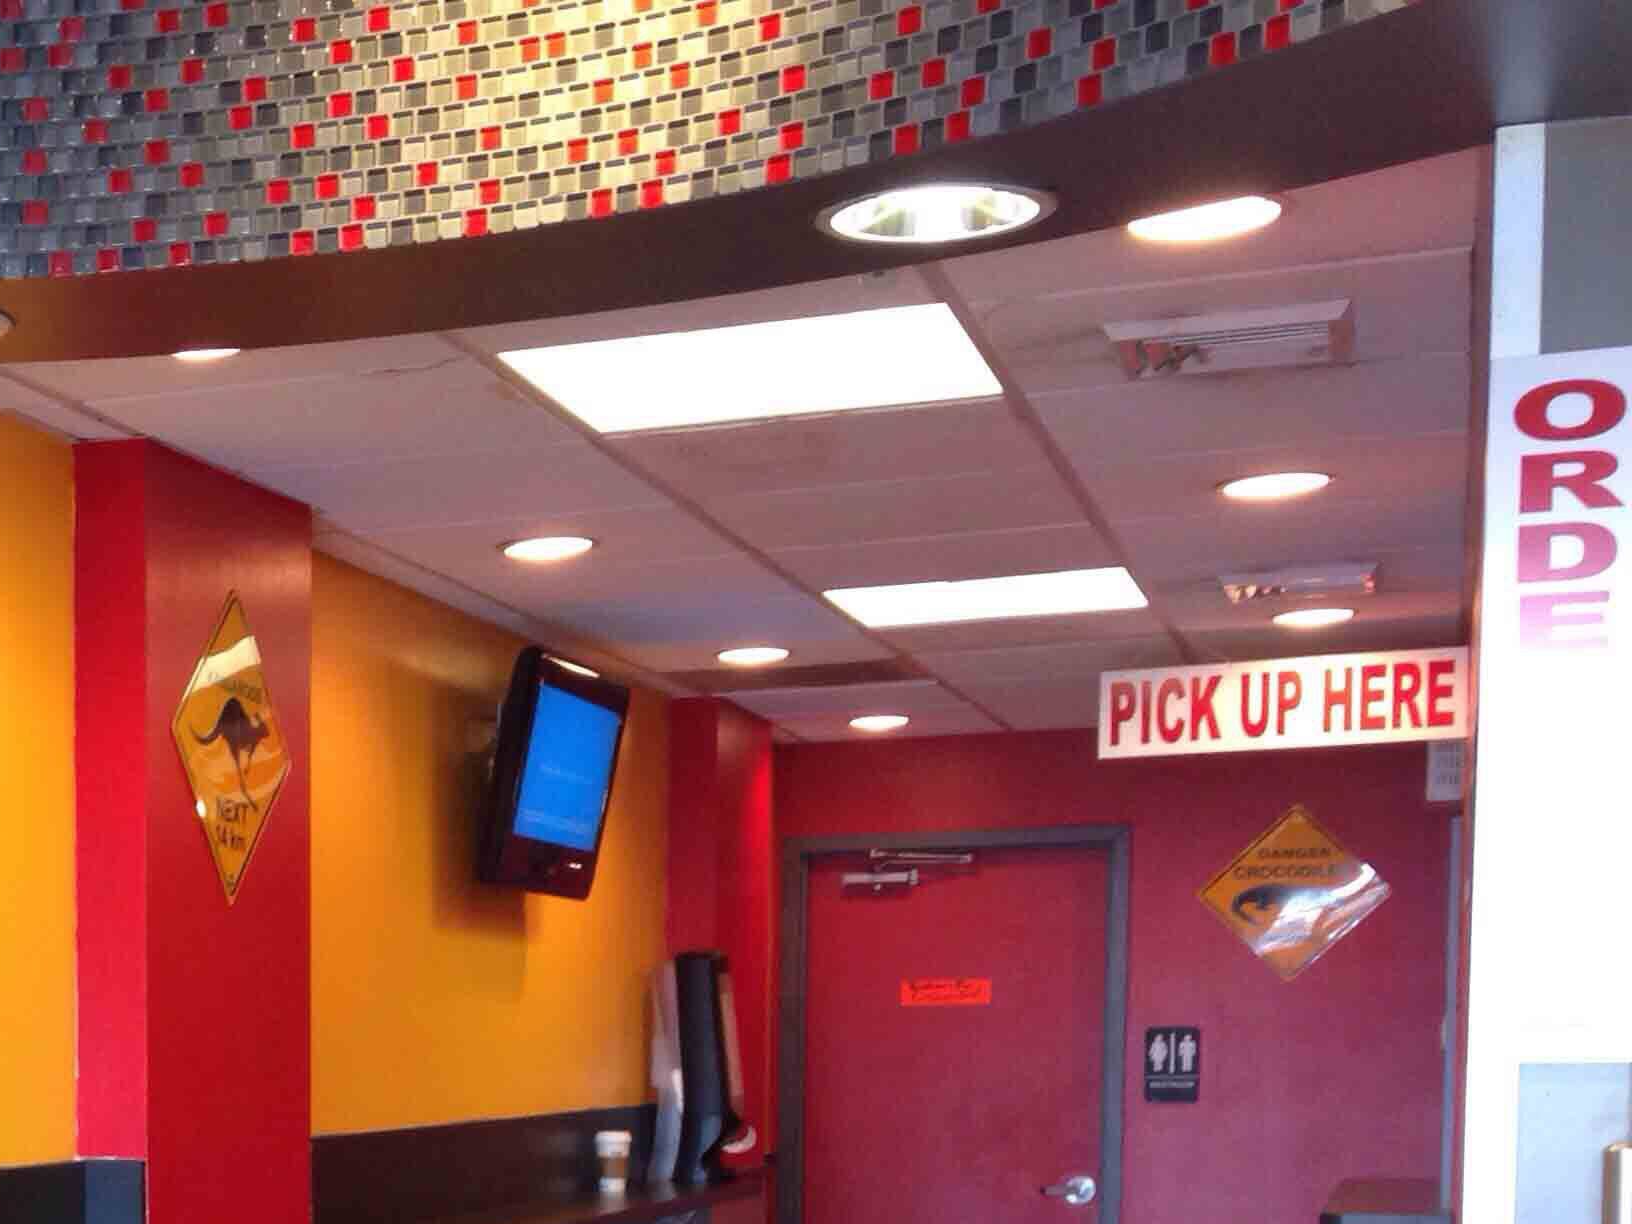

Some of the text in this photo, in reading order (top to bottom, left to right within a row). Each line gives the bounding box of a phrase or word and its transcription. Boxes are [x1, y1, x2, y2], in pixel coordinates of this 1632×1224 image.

[1110, 659, 1456, 747] PICK UP HERE
